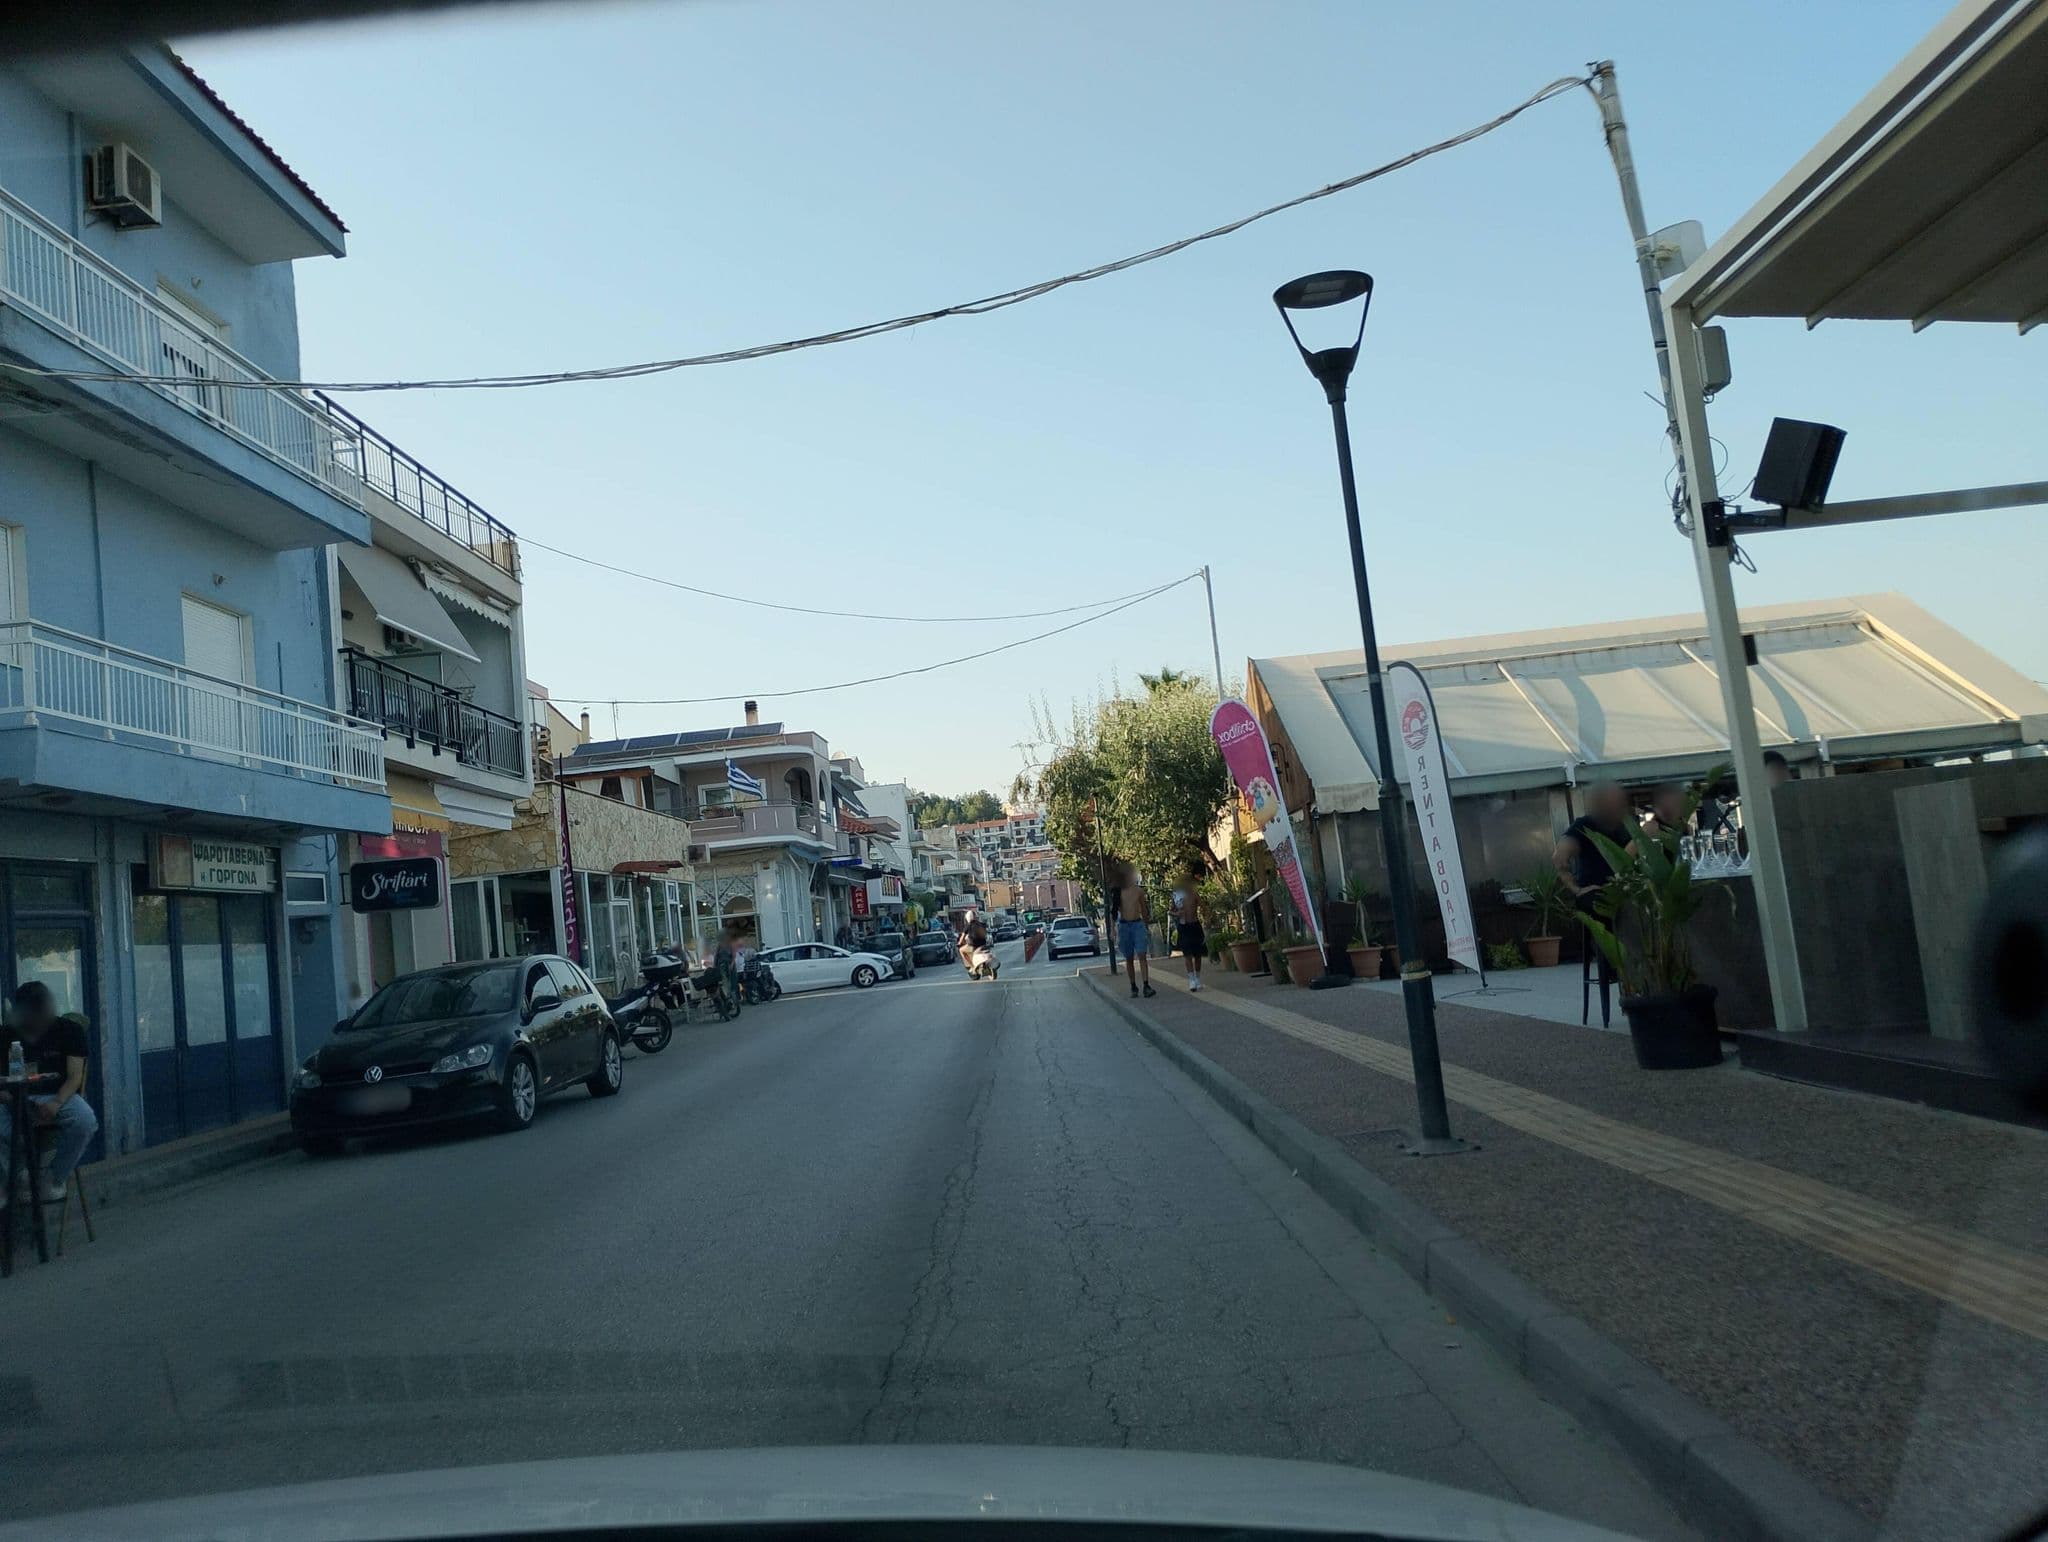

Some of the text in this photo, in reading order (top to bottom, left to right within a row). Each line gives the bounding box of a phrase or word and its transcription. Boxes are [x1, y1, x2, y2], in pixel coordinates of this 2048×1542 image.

[193, 843, 265, 866] ΨΑΡΟΤΑΒΕΡΝΑ
[209, 868, 258, 886] ΓΟΡΓΟΝΑ
[855, 888, 865, 914] ARKET
